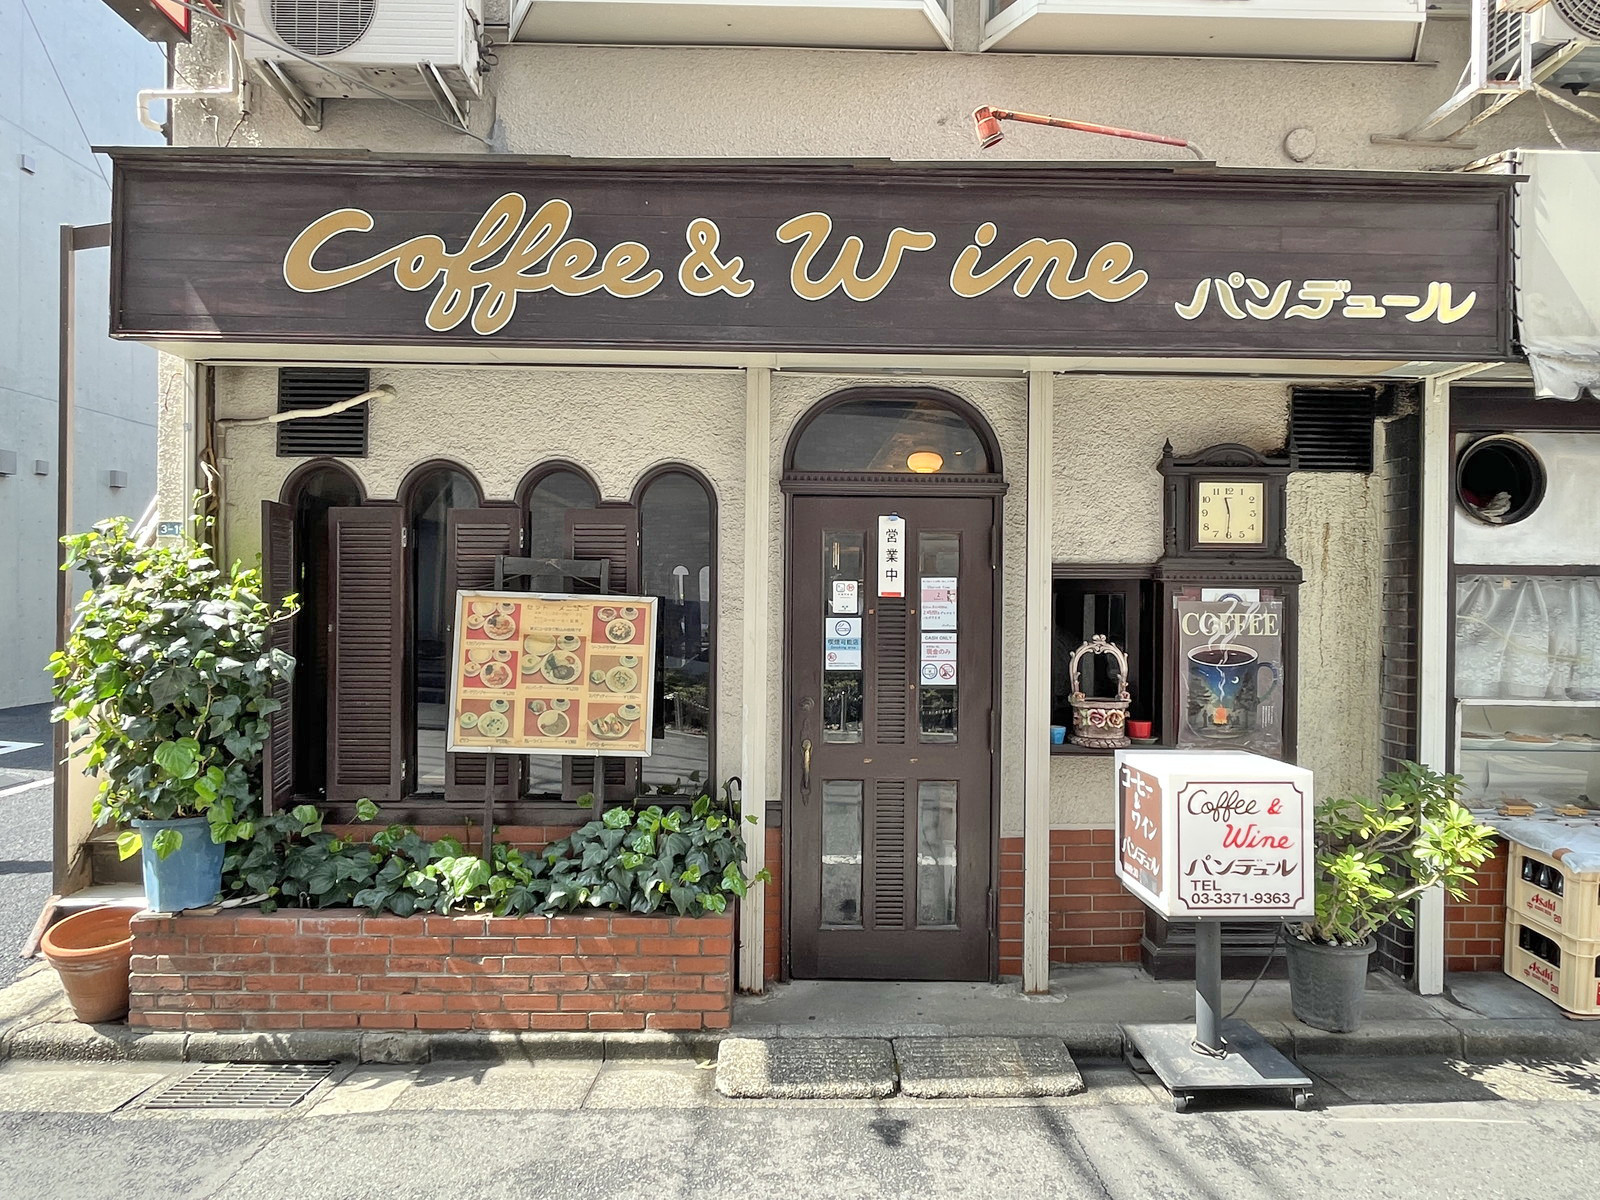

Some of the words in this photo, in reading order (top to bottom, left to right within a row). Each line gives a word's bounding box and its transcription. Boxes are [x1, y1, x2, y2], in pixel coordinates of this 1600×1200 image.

[283, 191, 664, 337] Coffee
[679, 217, 755, 298] &
[1174, 272, 1478, 325] パンデュール
[1213, 488, 1220, 496] 11
[1225, 487, 1234, 495] 12
[1240, 488, 1244, 496] 1
[1202, 496, 1211, 504] 10
[1248, 496, 1255, 504] 2
[1202, 509, 1209, 517] 9
[1203, 523, 1210, 531] 8
[1212, 530, 1219, 538] 7
[1248, 523, 1255, 531] 4
[885, 528, 899, 582] 営業中
[1182, 612, 1280, 637] COFFEE
[1121, 768, 1154, 797] コーヒー
[1187, 789, 1261, 822] Coffee
[1267, 798, 1283, 815] &
[1131, 810, 1158, 841] ワイン
[1222, 823, 1296, 849] Wine
[1184, 854, 1298, 877] パンデュール
[1191, 880, 1222, 892] TEL
[1191, 892, 1291, 905] 03-3371-9363
[1532, 893, 1556, 912] Asahi
[1529, 961, 1553, 981] Asahi
